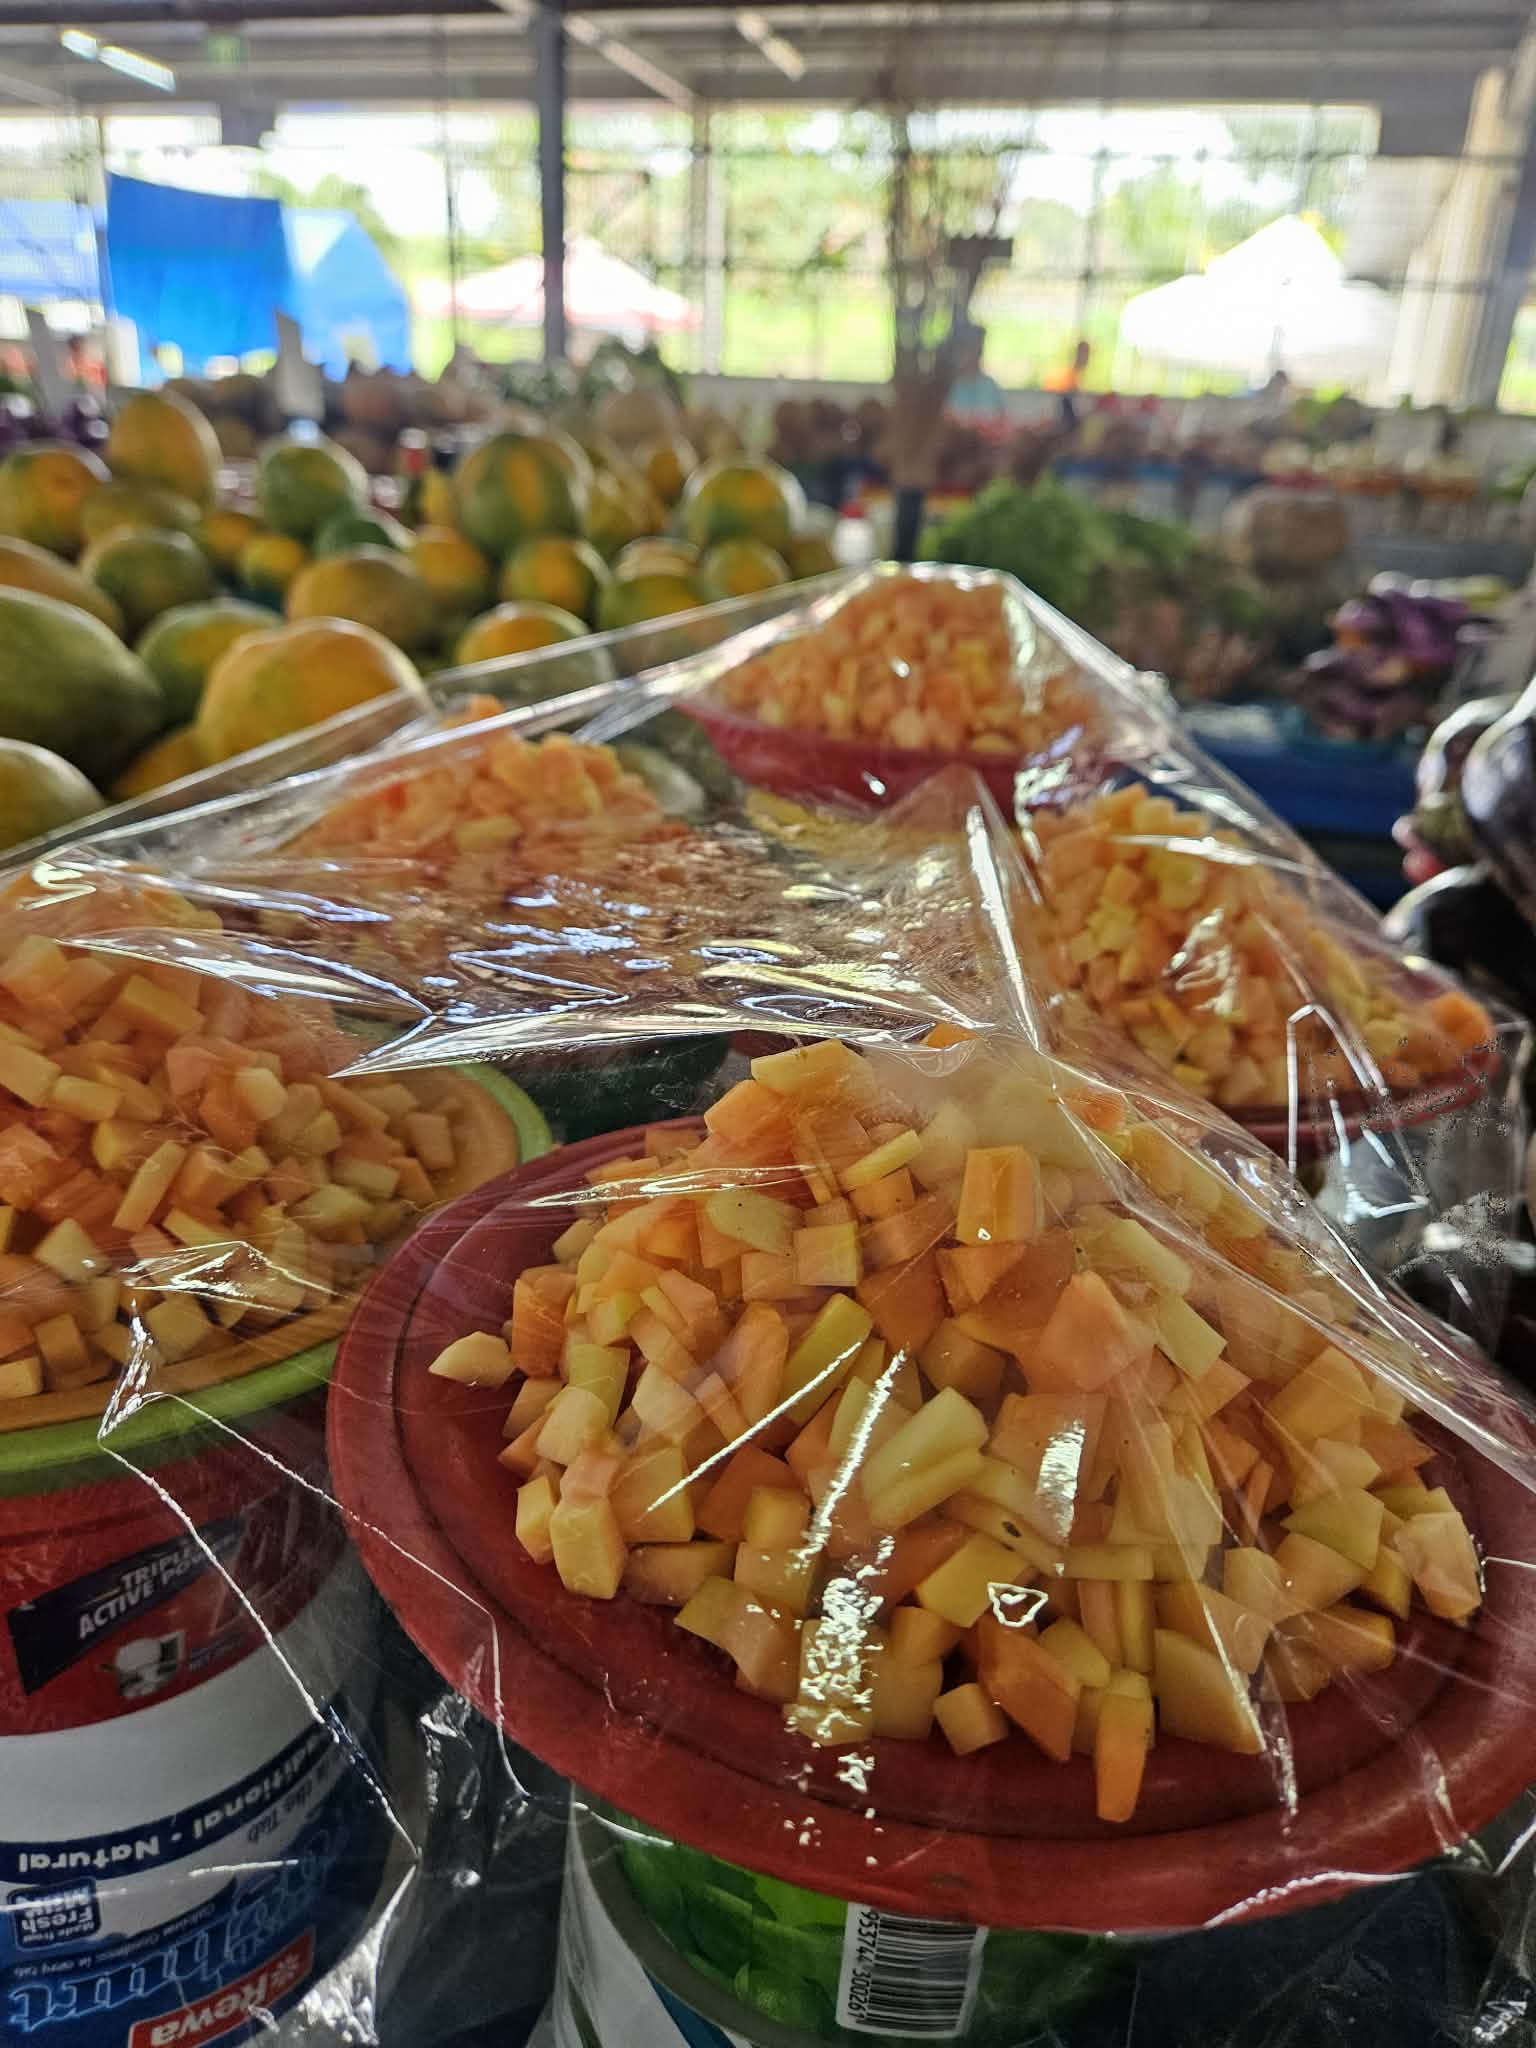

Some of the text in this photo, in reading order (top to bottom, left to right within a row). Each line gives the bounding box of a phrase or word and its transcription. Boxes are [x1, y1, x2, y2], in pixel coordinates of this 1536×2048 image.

[78, 1582, 155, 1640] ACTIVE
[18, 1836, 160, 1873] Natural
[21, 1906, 93, 1933] Fresh
[150, 1974, 270, 2046] Rewa
[847, 1967, 871, 2020] 300261
